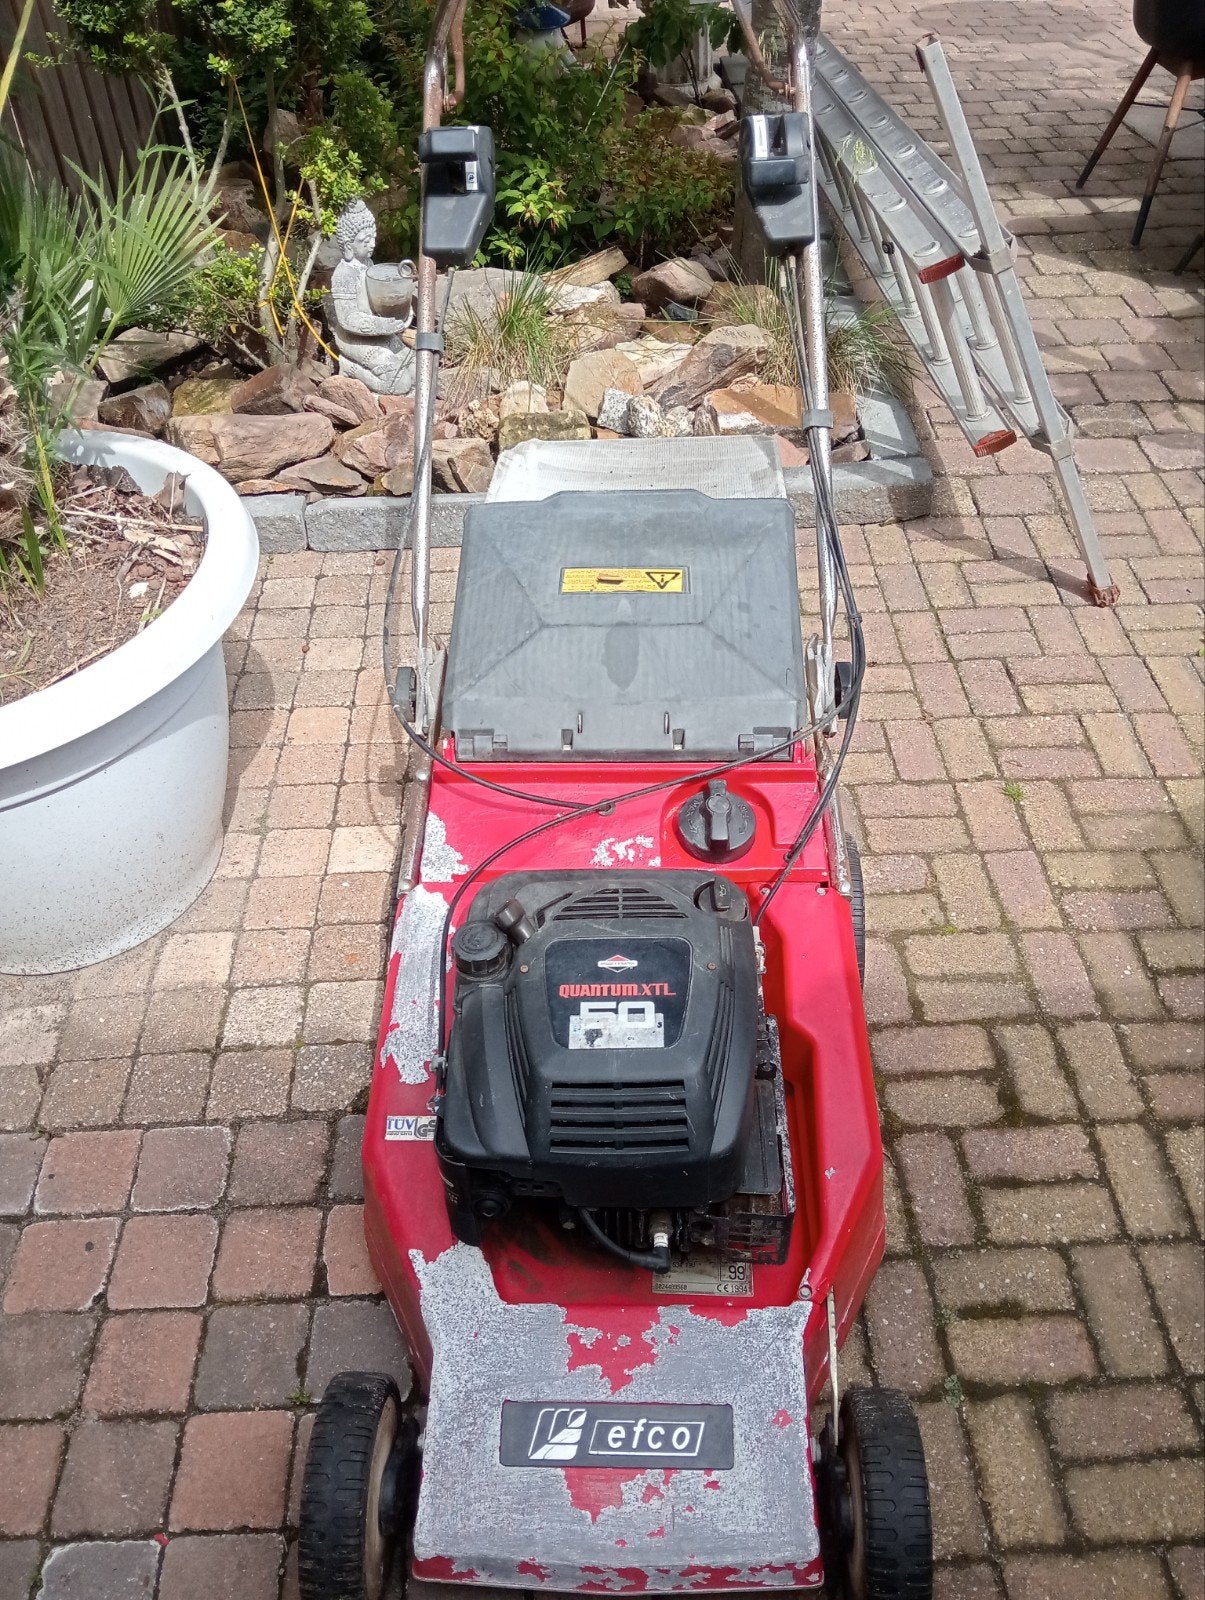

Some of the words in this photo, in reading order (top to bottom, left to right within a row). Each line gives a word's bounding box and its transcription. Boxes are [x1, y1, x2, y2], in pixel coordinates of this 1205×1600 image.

[559, 983, 639, 998] QUANTUM
[580, 1001, 655, 1028] 50
[728, 1265, 745, 1280] 99
[607, 1418, 691, 1450] efco
